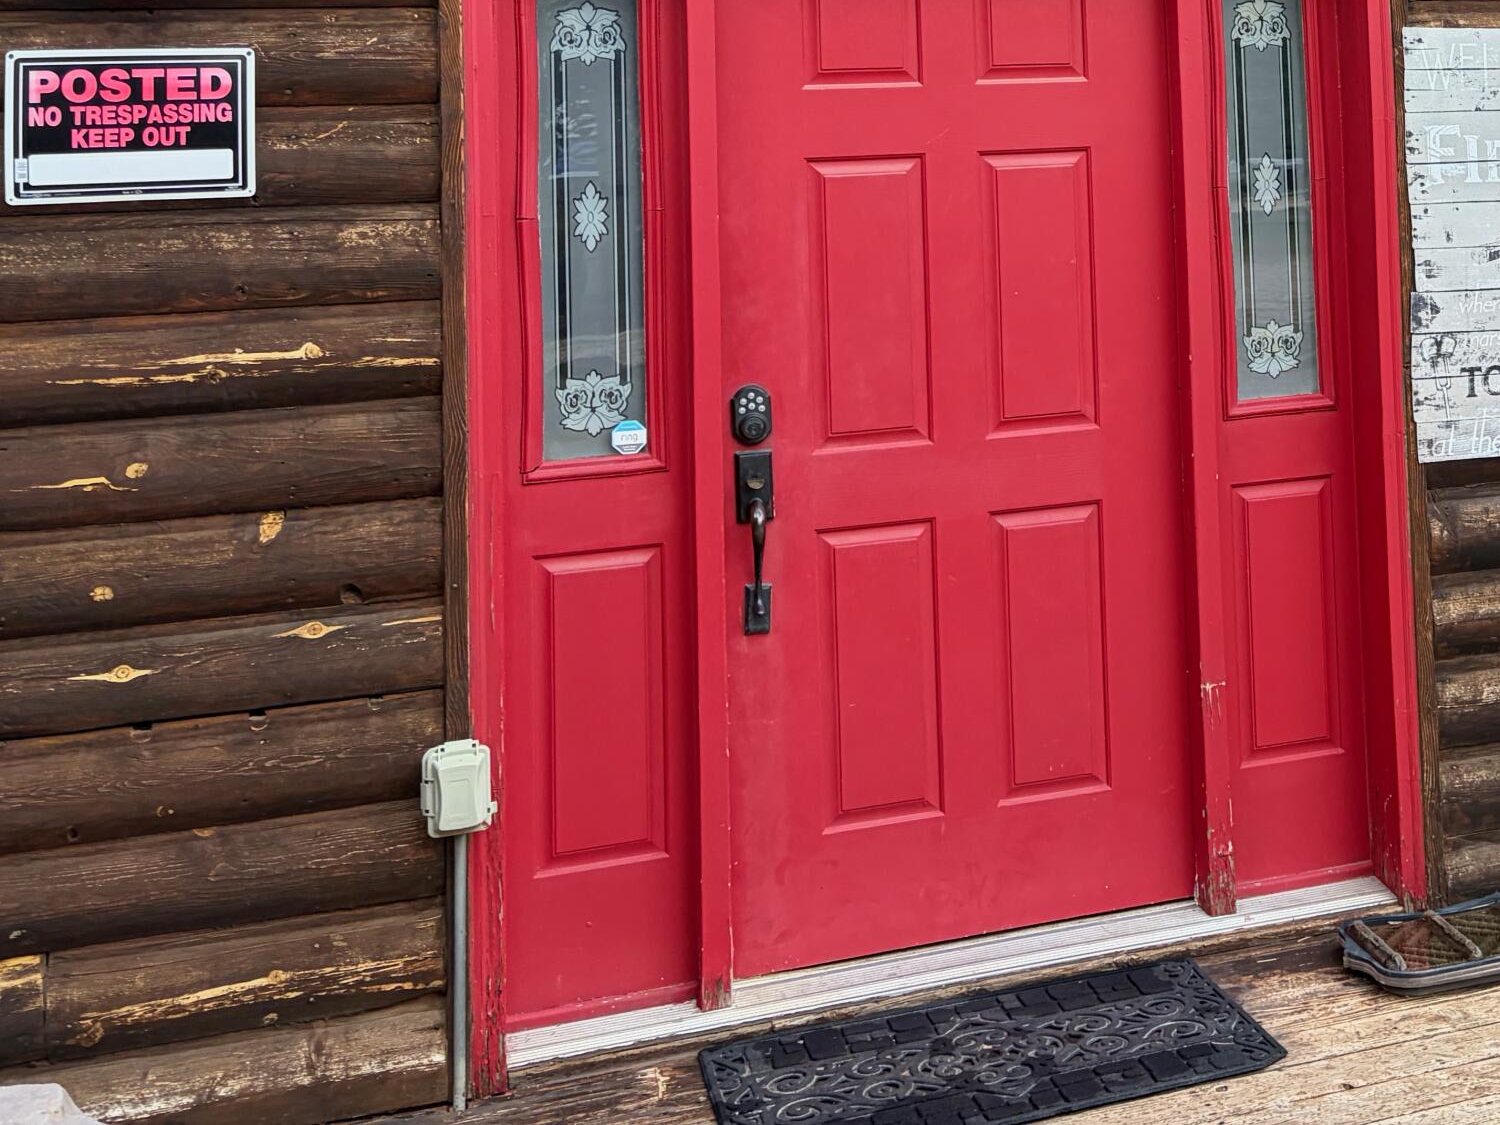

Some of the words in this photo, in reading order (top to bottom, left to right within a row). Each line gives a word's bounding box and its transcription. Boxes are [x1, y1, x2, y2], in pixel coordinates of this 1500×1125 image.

[28, 67, 233, 104] POSTED
[28, 106, 62, 127] NO
[69, 103, 233, 125] TRESPASSING
[71, 128, 135, 149] KEEP
[142, 126, 191, 146] OUT
[1432, 424, 1456, 457] at
